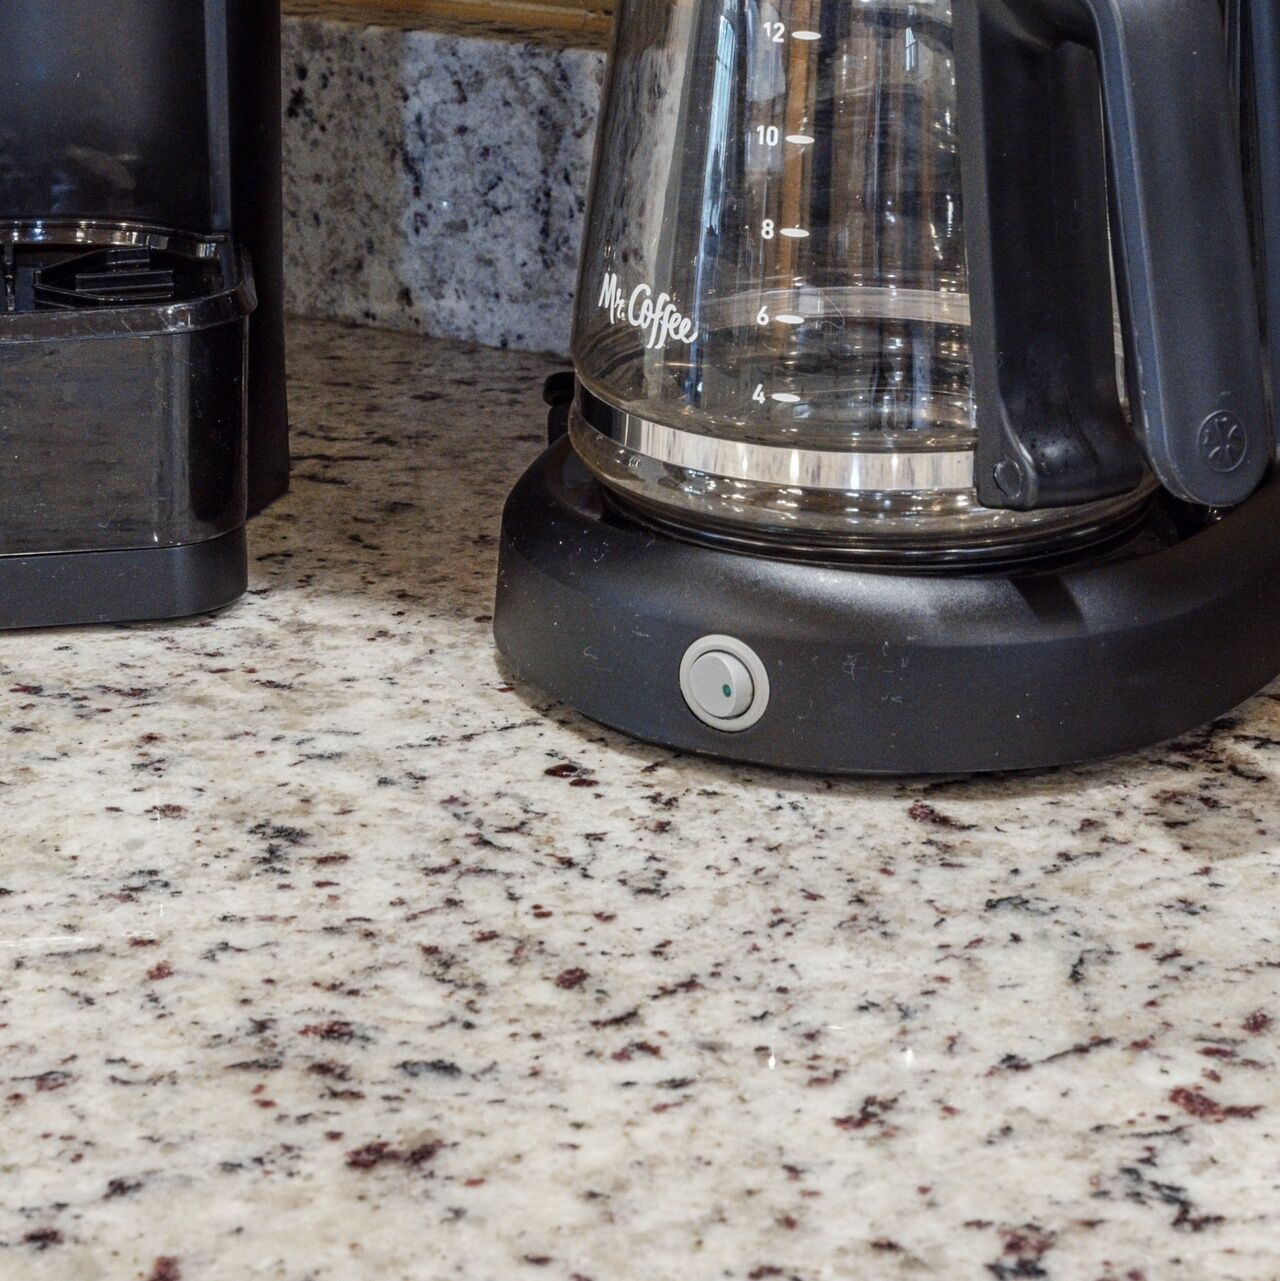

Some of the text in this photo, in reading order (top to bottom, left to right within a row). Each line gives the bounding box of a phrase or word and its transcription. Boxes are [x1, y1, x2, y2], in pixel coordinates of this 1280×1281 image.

[762, 21, 785, 44] 12
[756, 124, 780, 147] 10
[761, 219, 775, 240] 8
[598, 273, 699, 349] Mr. Coffee
[756, 305, 770, 326] 6
[751, 384, 766, 404] 4
